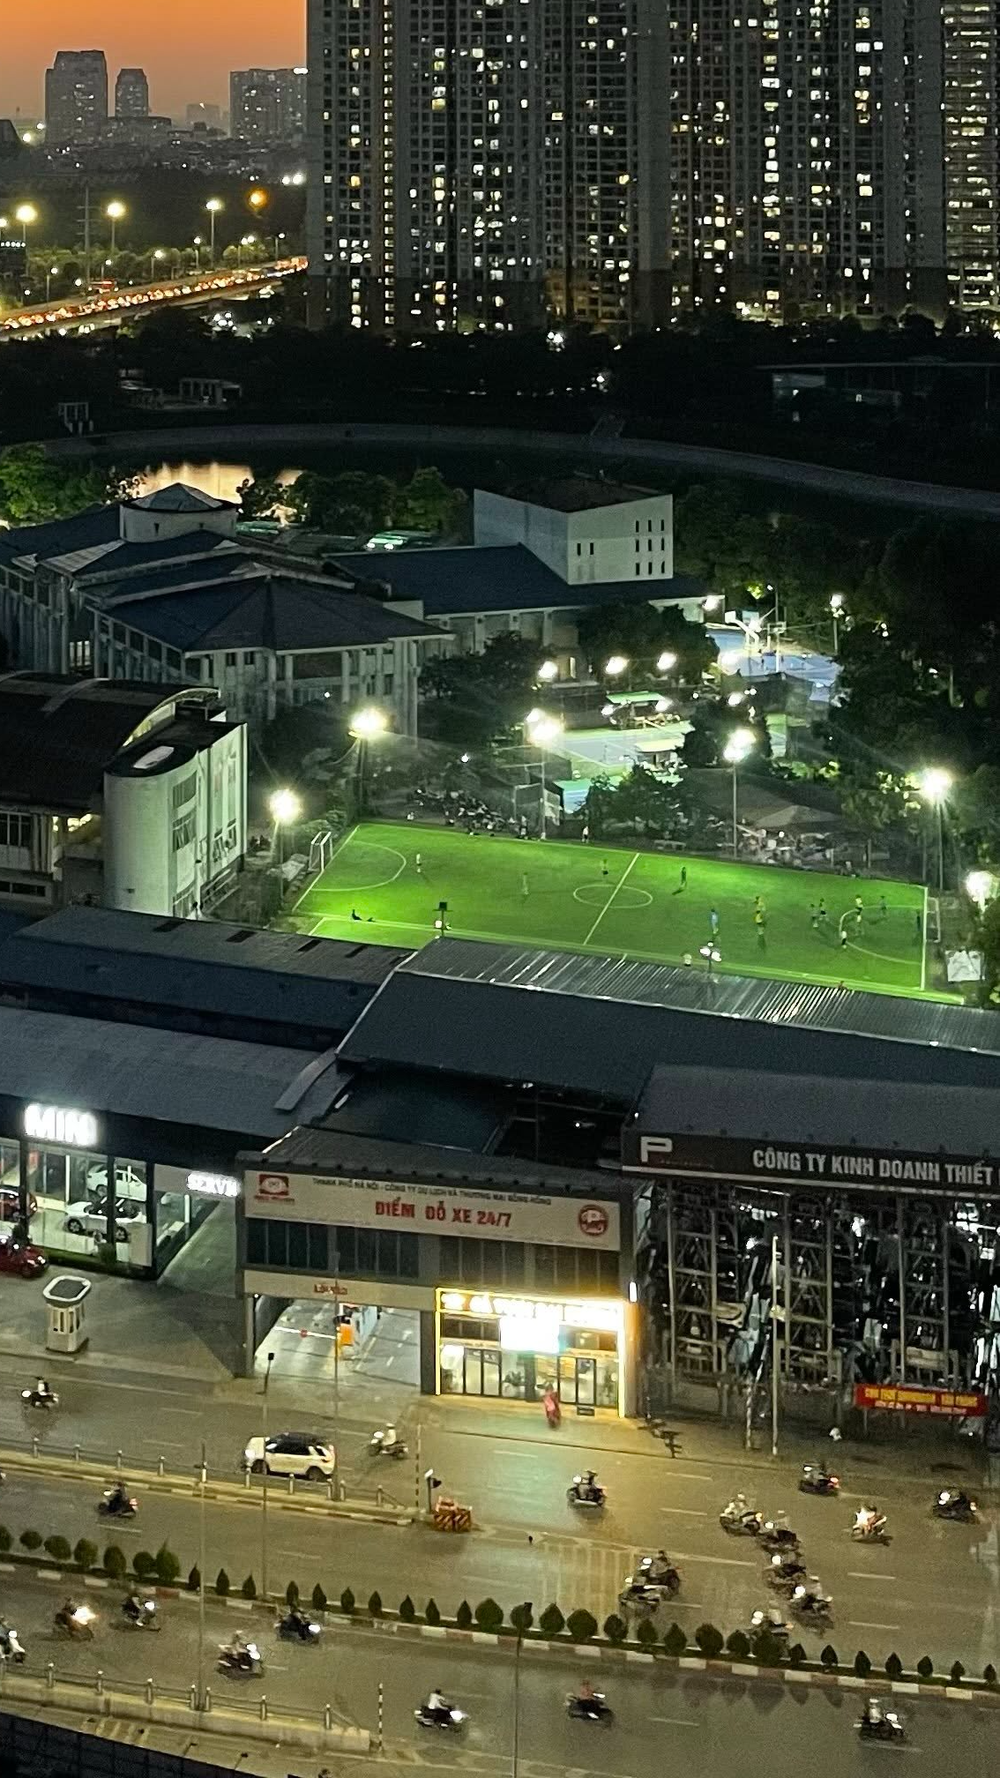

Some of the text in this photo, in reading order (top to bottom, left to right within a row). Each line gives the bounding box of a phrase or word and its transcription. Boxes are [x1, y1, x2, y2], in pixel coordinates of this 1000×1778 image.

[641, 1136, 672, 1163] P
[753, 1147, 993, 1186] CÔNG TY KINH DOANH THIẾT
[453, 1208, 472, 1223] XE
[477, 1210, 512, 1227] 24/7
